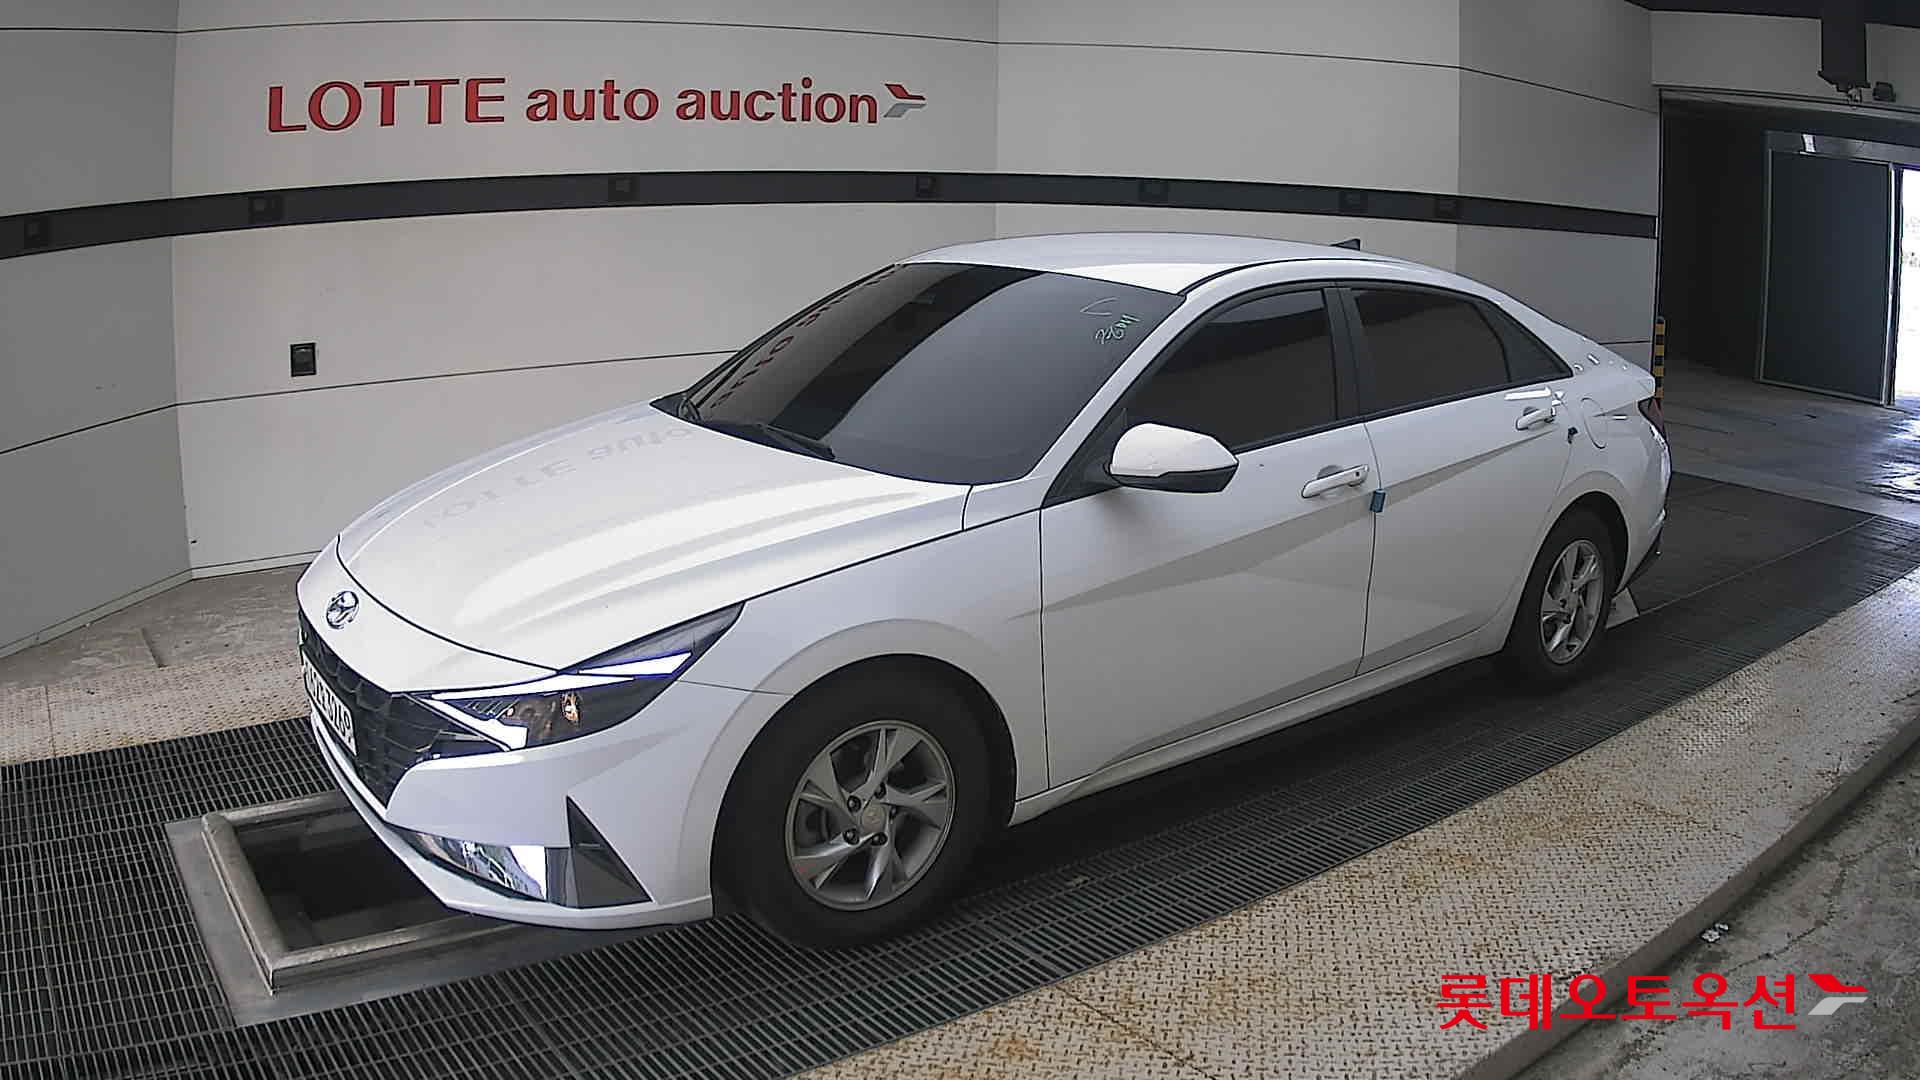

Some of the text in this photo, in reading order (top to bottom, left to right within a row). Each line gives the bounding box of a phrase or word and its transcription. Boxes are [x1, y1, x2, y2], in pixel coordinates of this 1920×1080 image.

[268, 77, 878, 132] LOTTE auto auction
